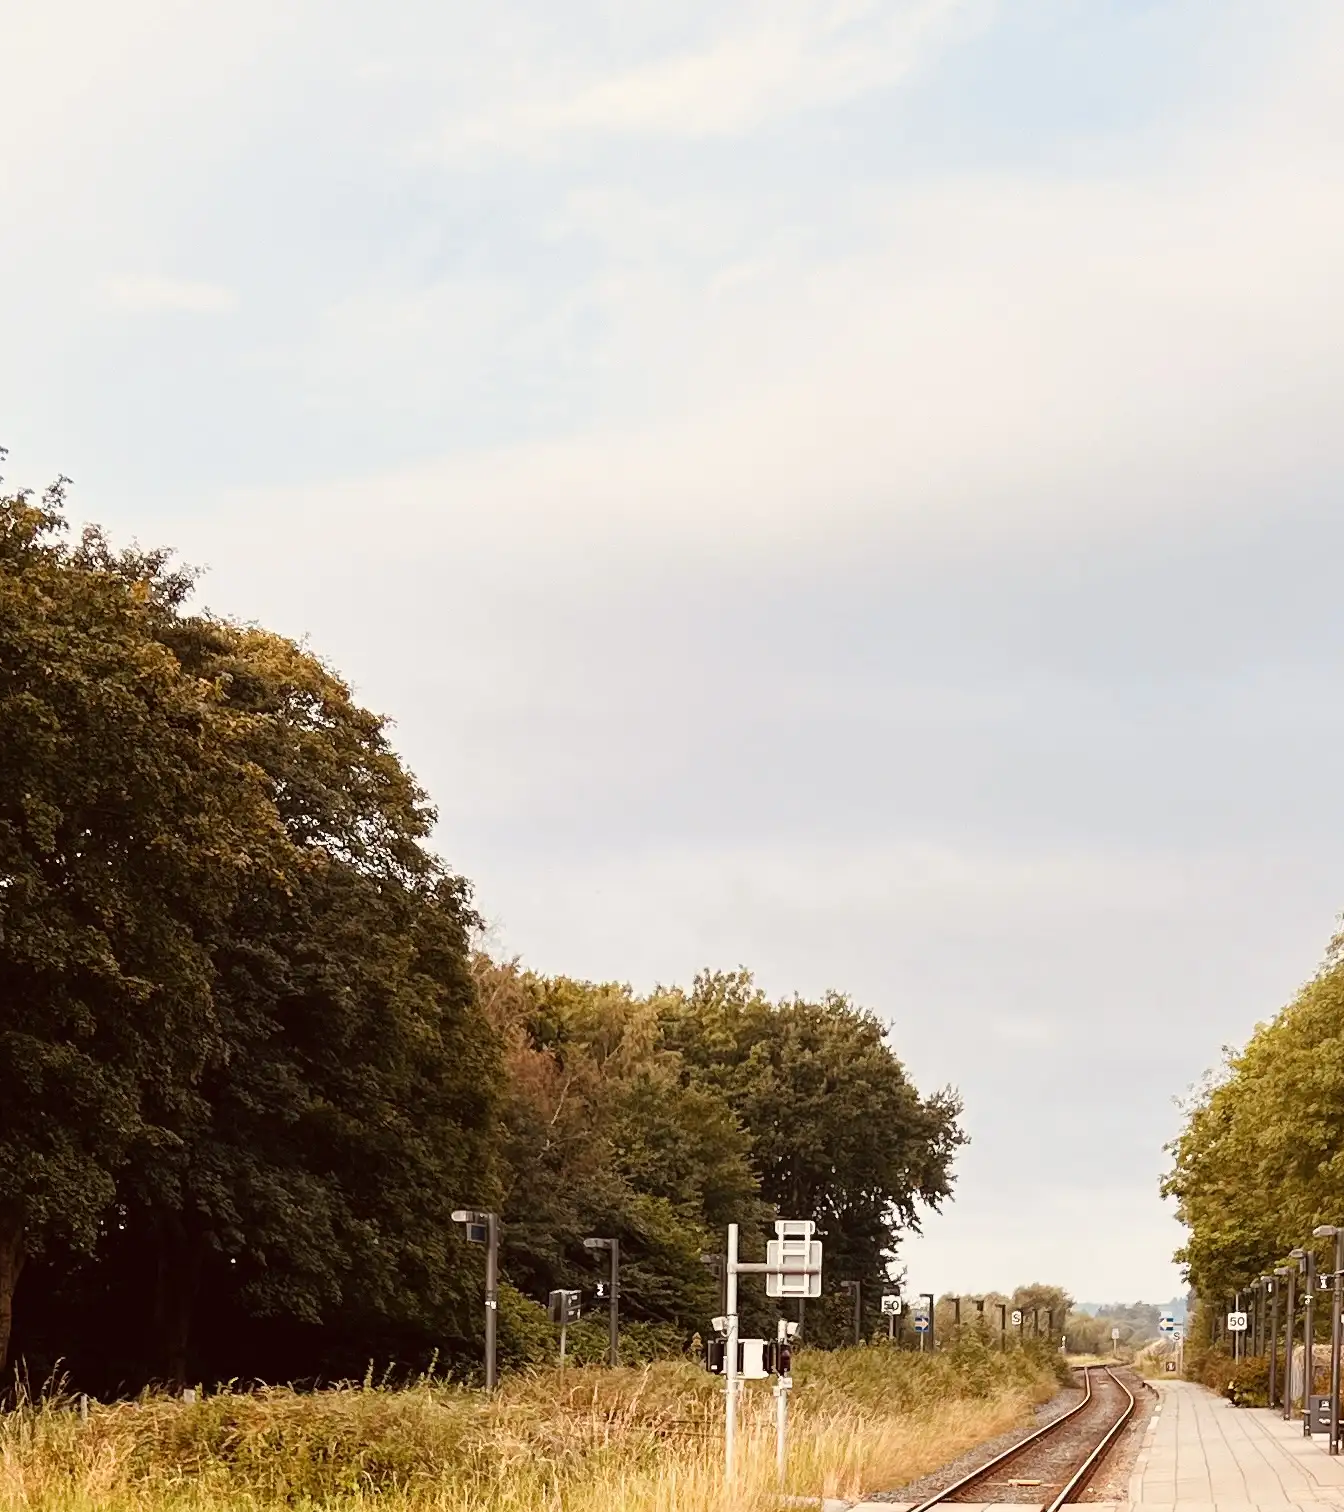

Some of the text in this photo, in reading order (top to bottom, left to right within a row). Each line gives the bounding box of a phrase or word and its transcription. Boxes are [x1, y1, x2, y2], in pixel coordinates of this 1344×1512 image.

[883, 1300, 900, 1311] 50
[1229, 1316, 1245, 1327] 50
[1173, 1331, 1181, 1341] S
